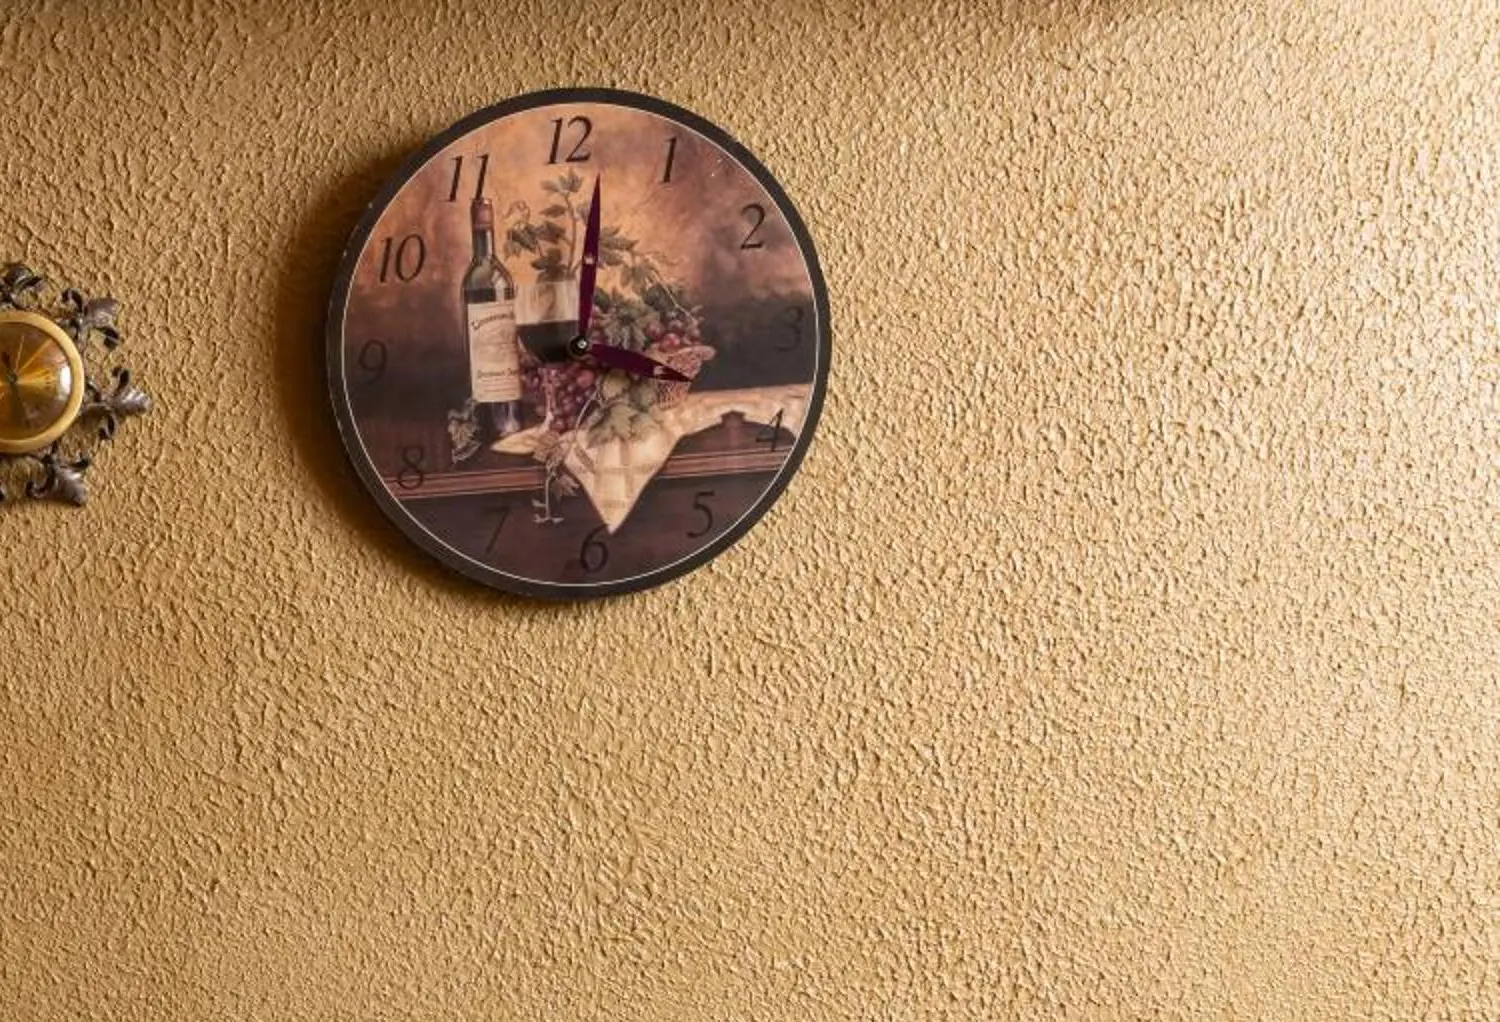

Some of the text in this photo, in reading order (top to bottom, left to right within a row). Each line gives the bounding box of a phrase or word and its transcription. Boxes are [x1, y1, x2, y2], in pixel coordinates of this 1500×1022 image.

[547, 116, 593, 165] 12
[662, 136, 678, 184] 1
[449, 153, 491, 202] 11
[741, 204, 766, 250] 2
[379, 234, 427, 284] 10
[777, 306, 804, 352] 3
[358, 340, 388, 386] 9
[755, 408, 784, 453] 4
[394, 445, 427, 490] 8
[484, 507, 510, 555] 7
[687, 491, 716, 539] 5
[579, 527, 610, 573] 6
